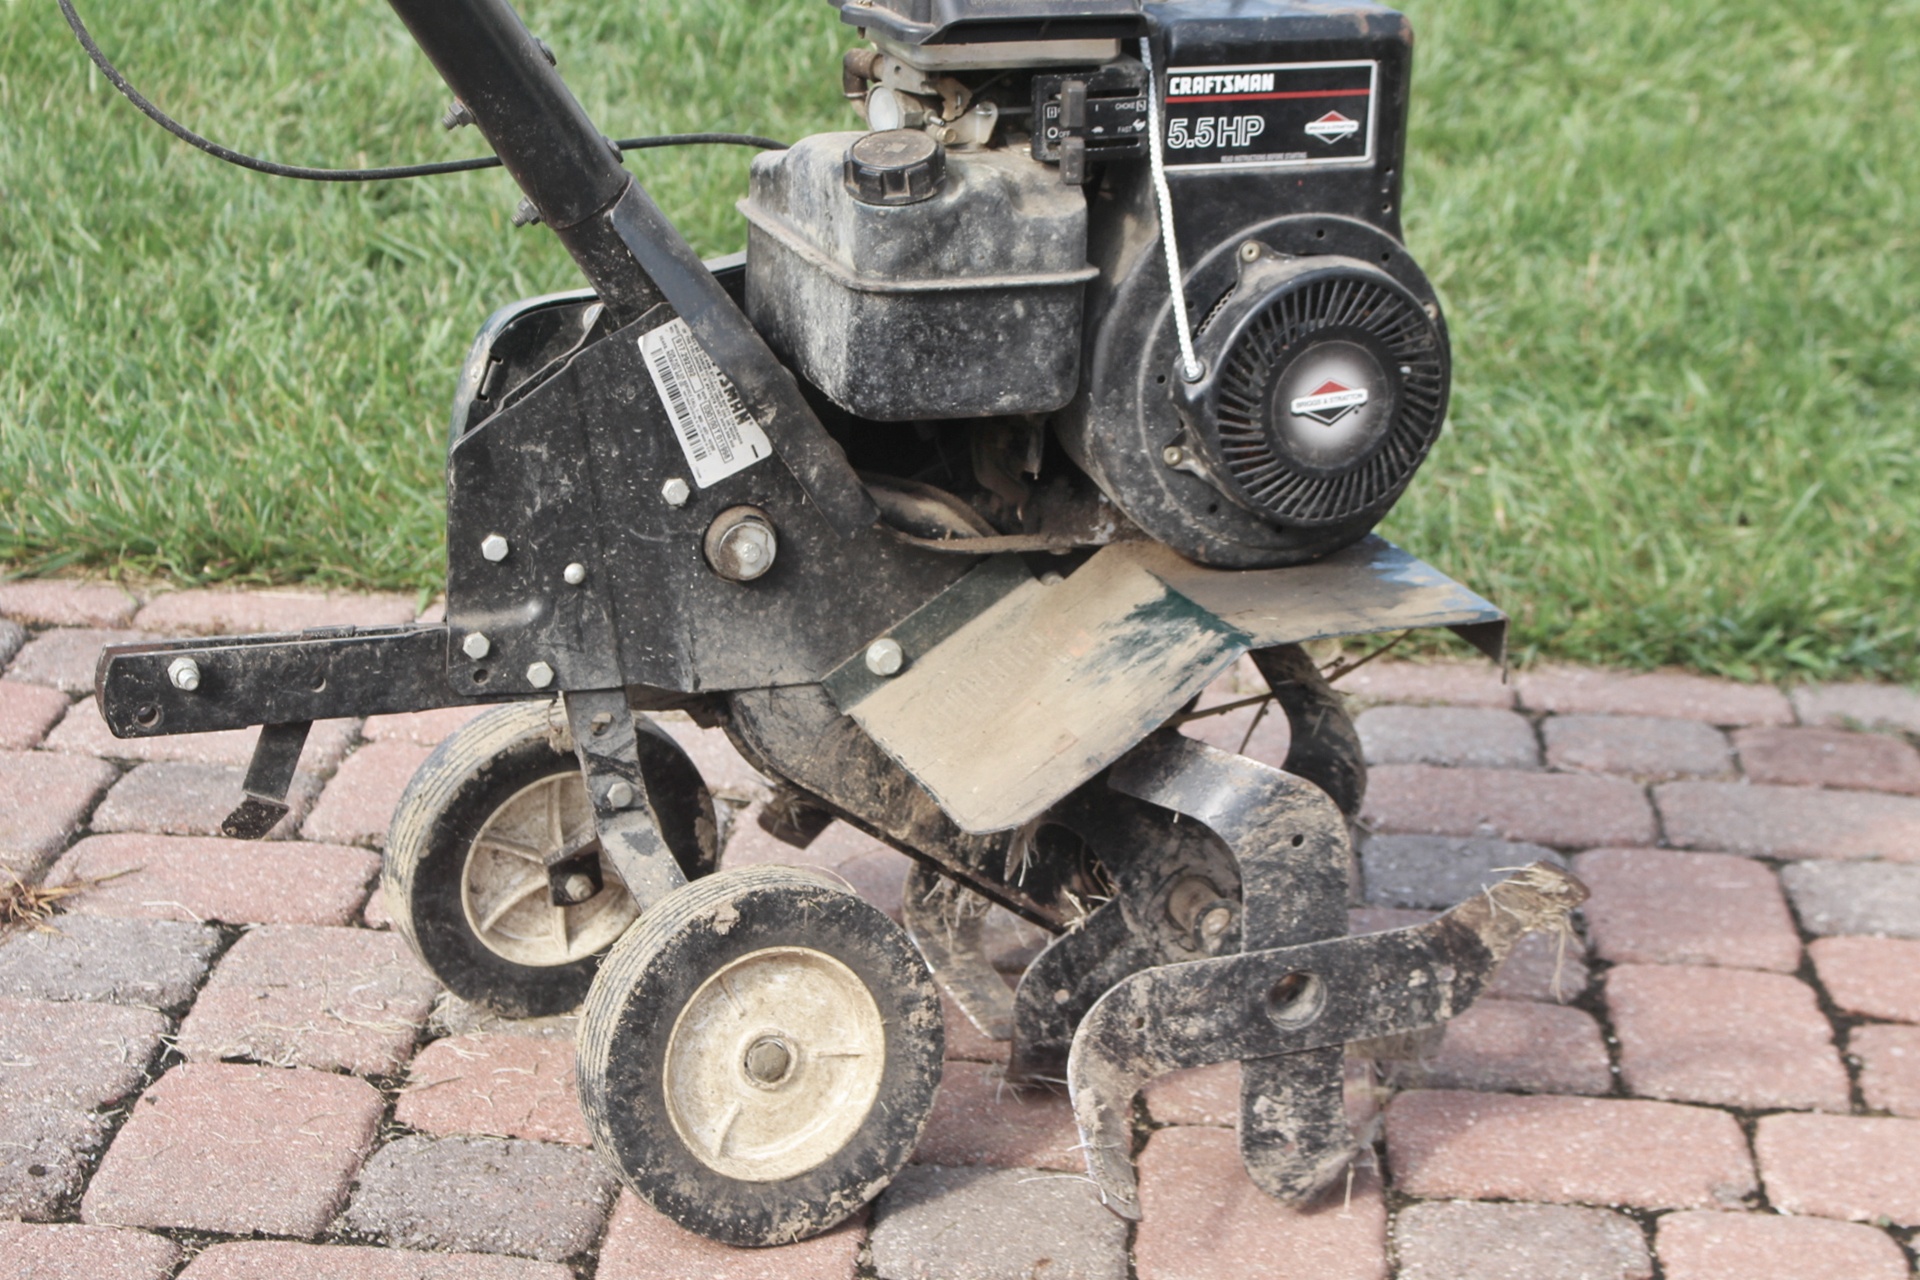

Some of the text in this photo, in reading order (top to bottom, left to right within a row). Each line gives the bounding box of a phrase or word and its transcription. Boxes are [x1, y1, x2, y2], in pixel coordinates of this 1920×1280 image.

[1169, 73, 1275, 95] CRAFTSMAN
[1167, 115, 1265, 149] 5.5 HP
